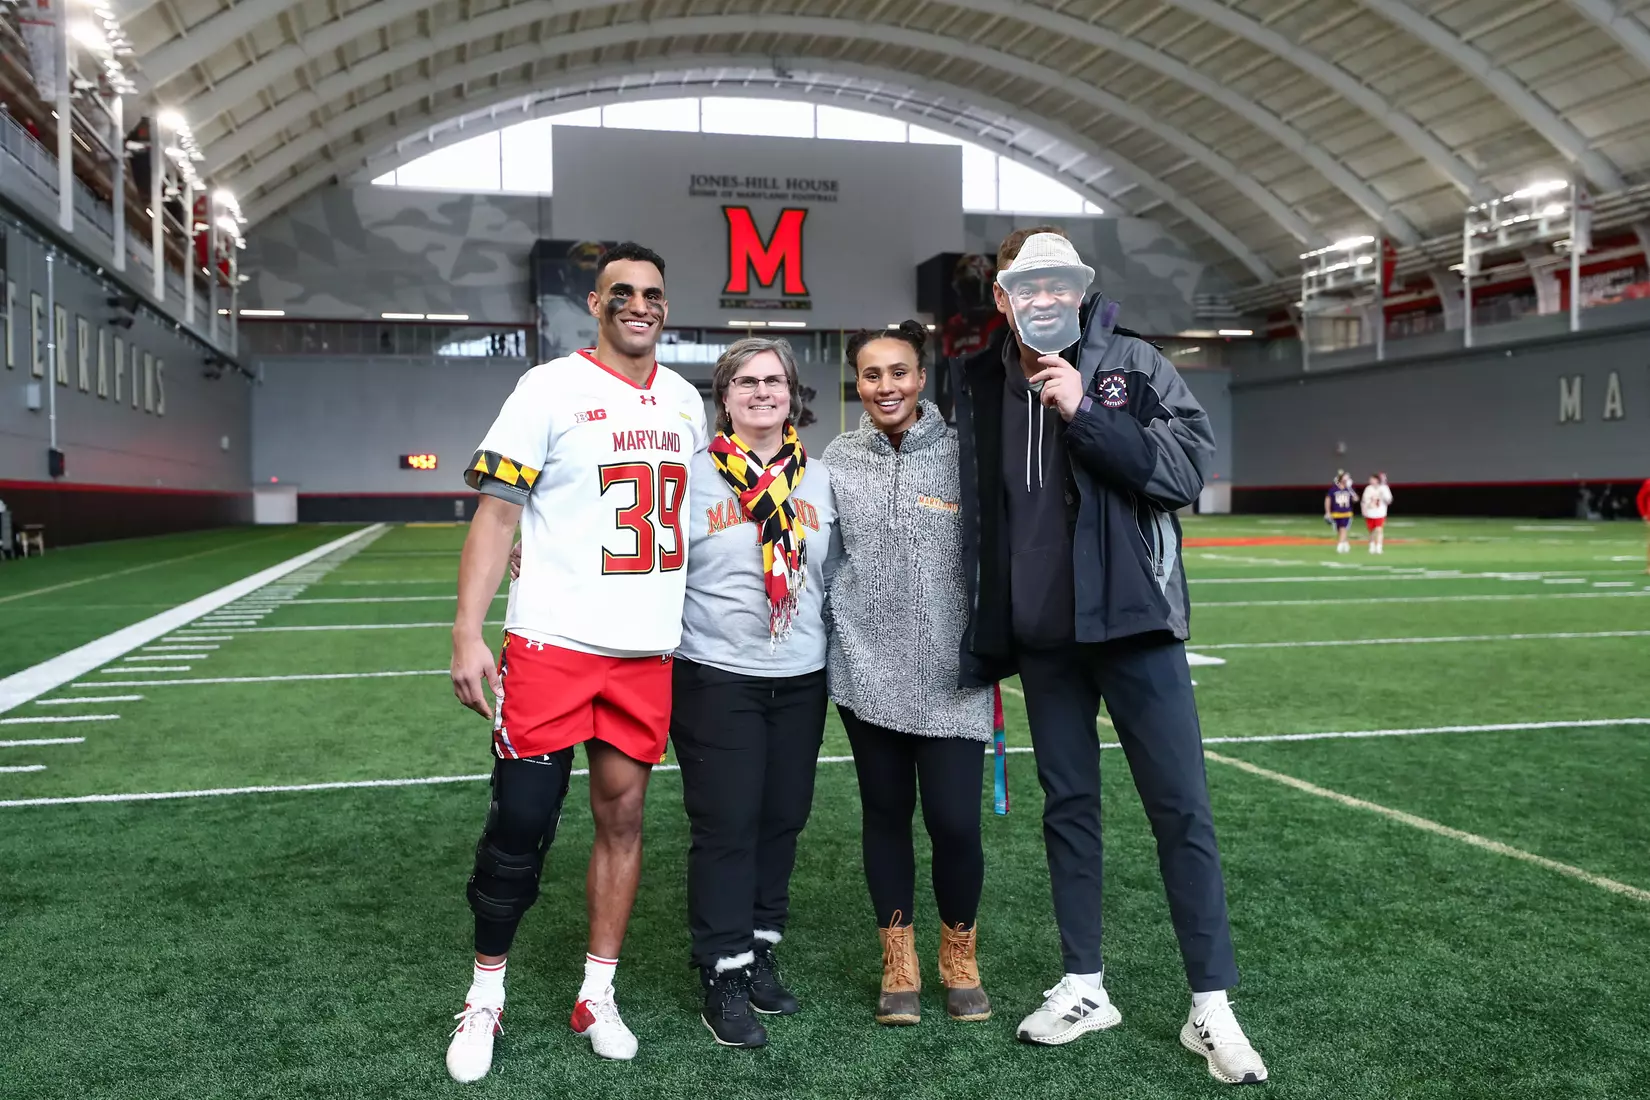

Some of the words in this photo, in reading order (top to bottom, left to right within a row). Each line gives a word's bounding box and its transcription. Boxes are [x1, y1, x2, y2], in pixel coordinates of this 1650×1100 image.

[690, 174, 780, 190] JONES-HILL
[786, 177, 839, 192] HOUSE
[720, 205, 810, 296] M
[612, 430, 681, 453] MARYLAND
[917, 495, 960, 512] MARYLAND
[598, 461, 687, 575] 39
